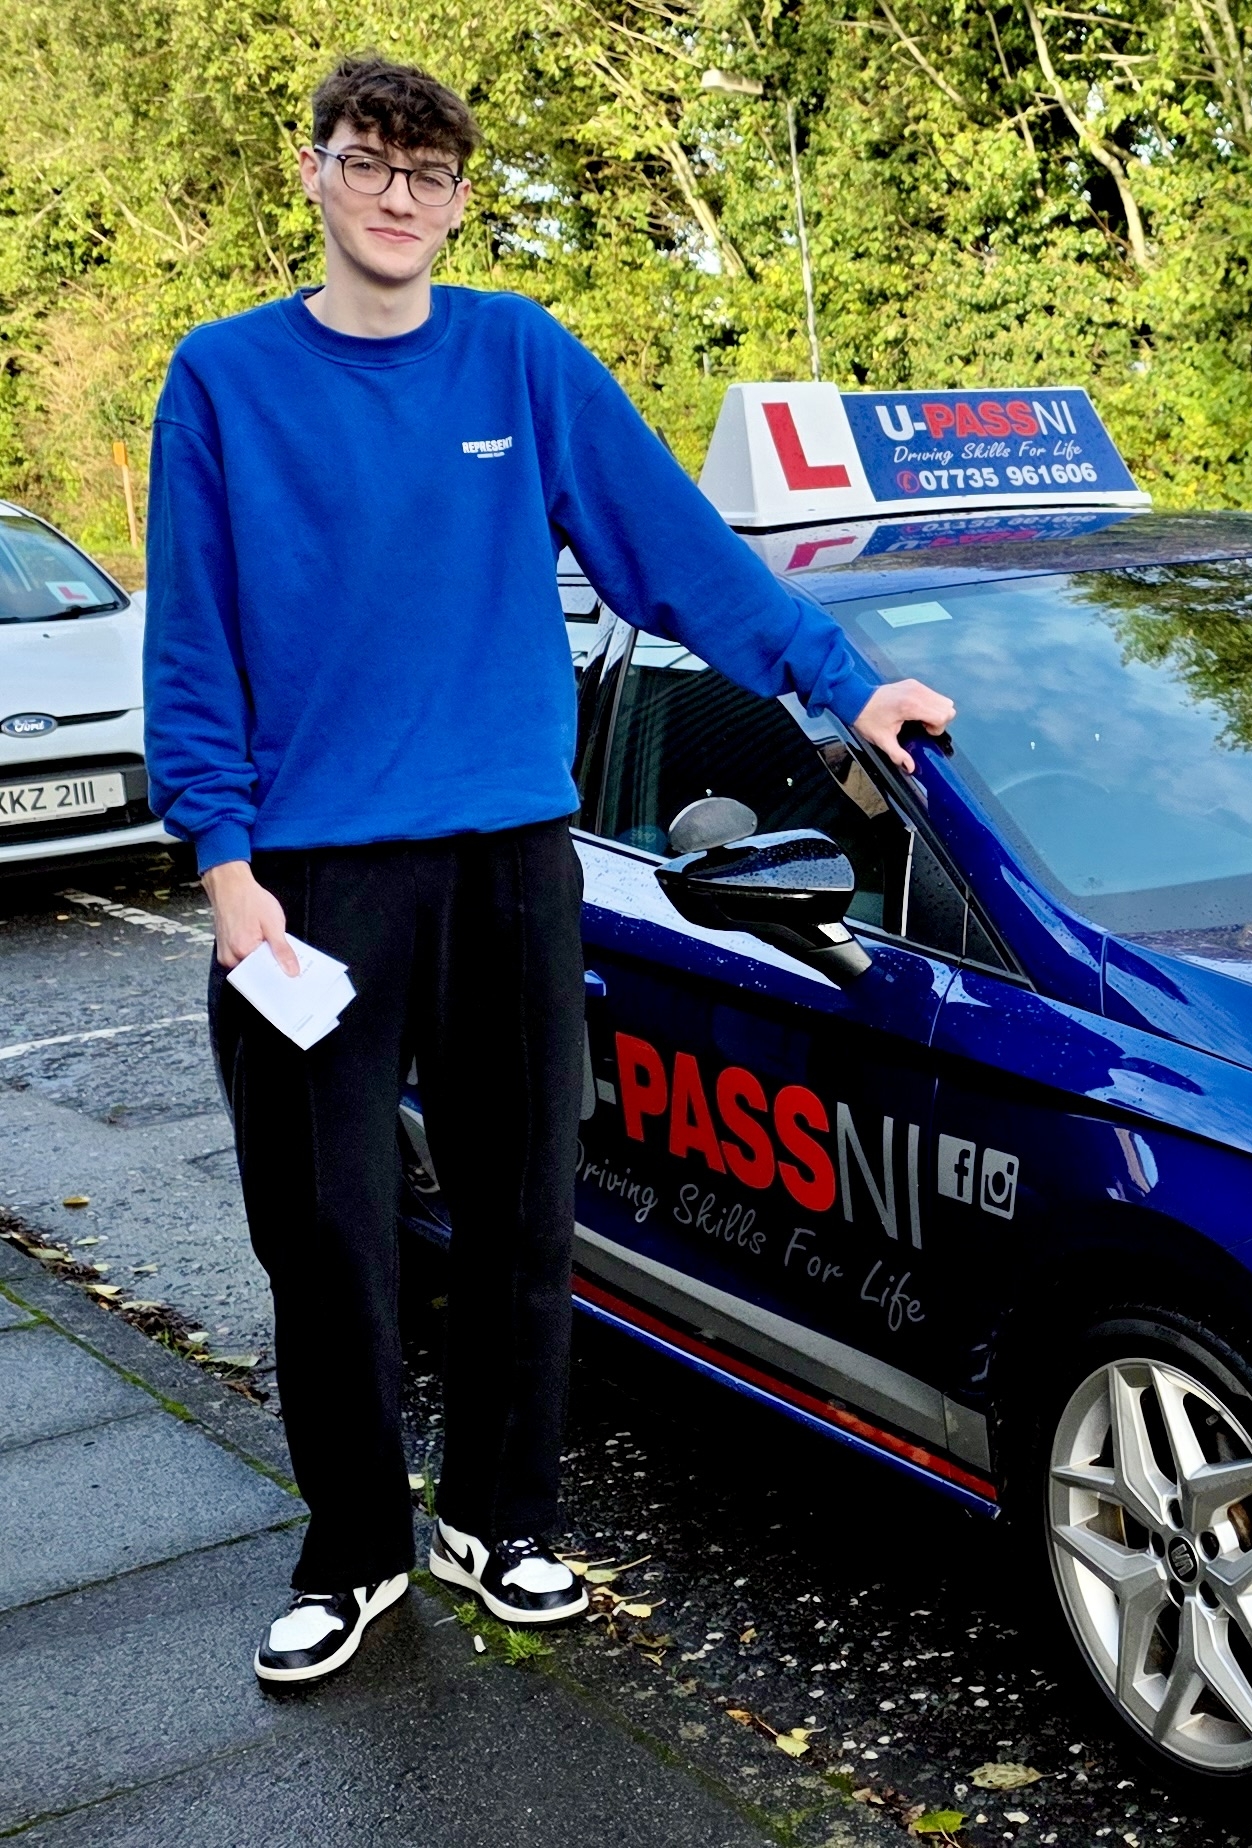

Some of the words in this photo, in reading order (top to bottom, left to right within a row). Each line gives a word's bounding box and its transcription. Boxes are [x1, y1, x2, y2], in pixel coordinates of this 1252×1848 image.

[875, 400, 1077, 441] U-PASSNI
[462, 436, 513, 454] REPRESENT
[761, 402, 852, 491] L
[894, 446, 954, 466] Driving
[961, 442, 1011, 459] Skills
[1018, 440, 1046, 458] For
[1053, 439, 1083, 461] Life
[918, 467, 999, 491] 07735
[1006, 462, 1098, 487] 961606
[57, 586, 89, 600] L
[13, 718, 45, 733] Ford
[674, 1183, 767, 1255] Skills
[784, 1227, 844, 1284] For
[860, 1260, 926, 1332] Life
